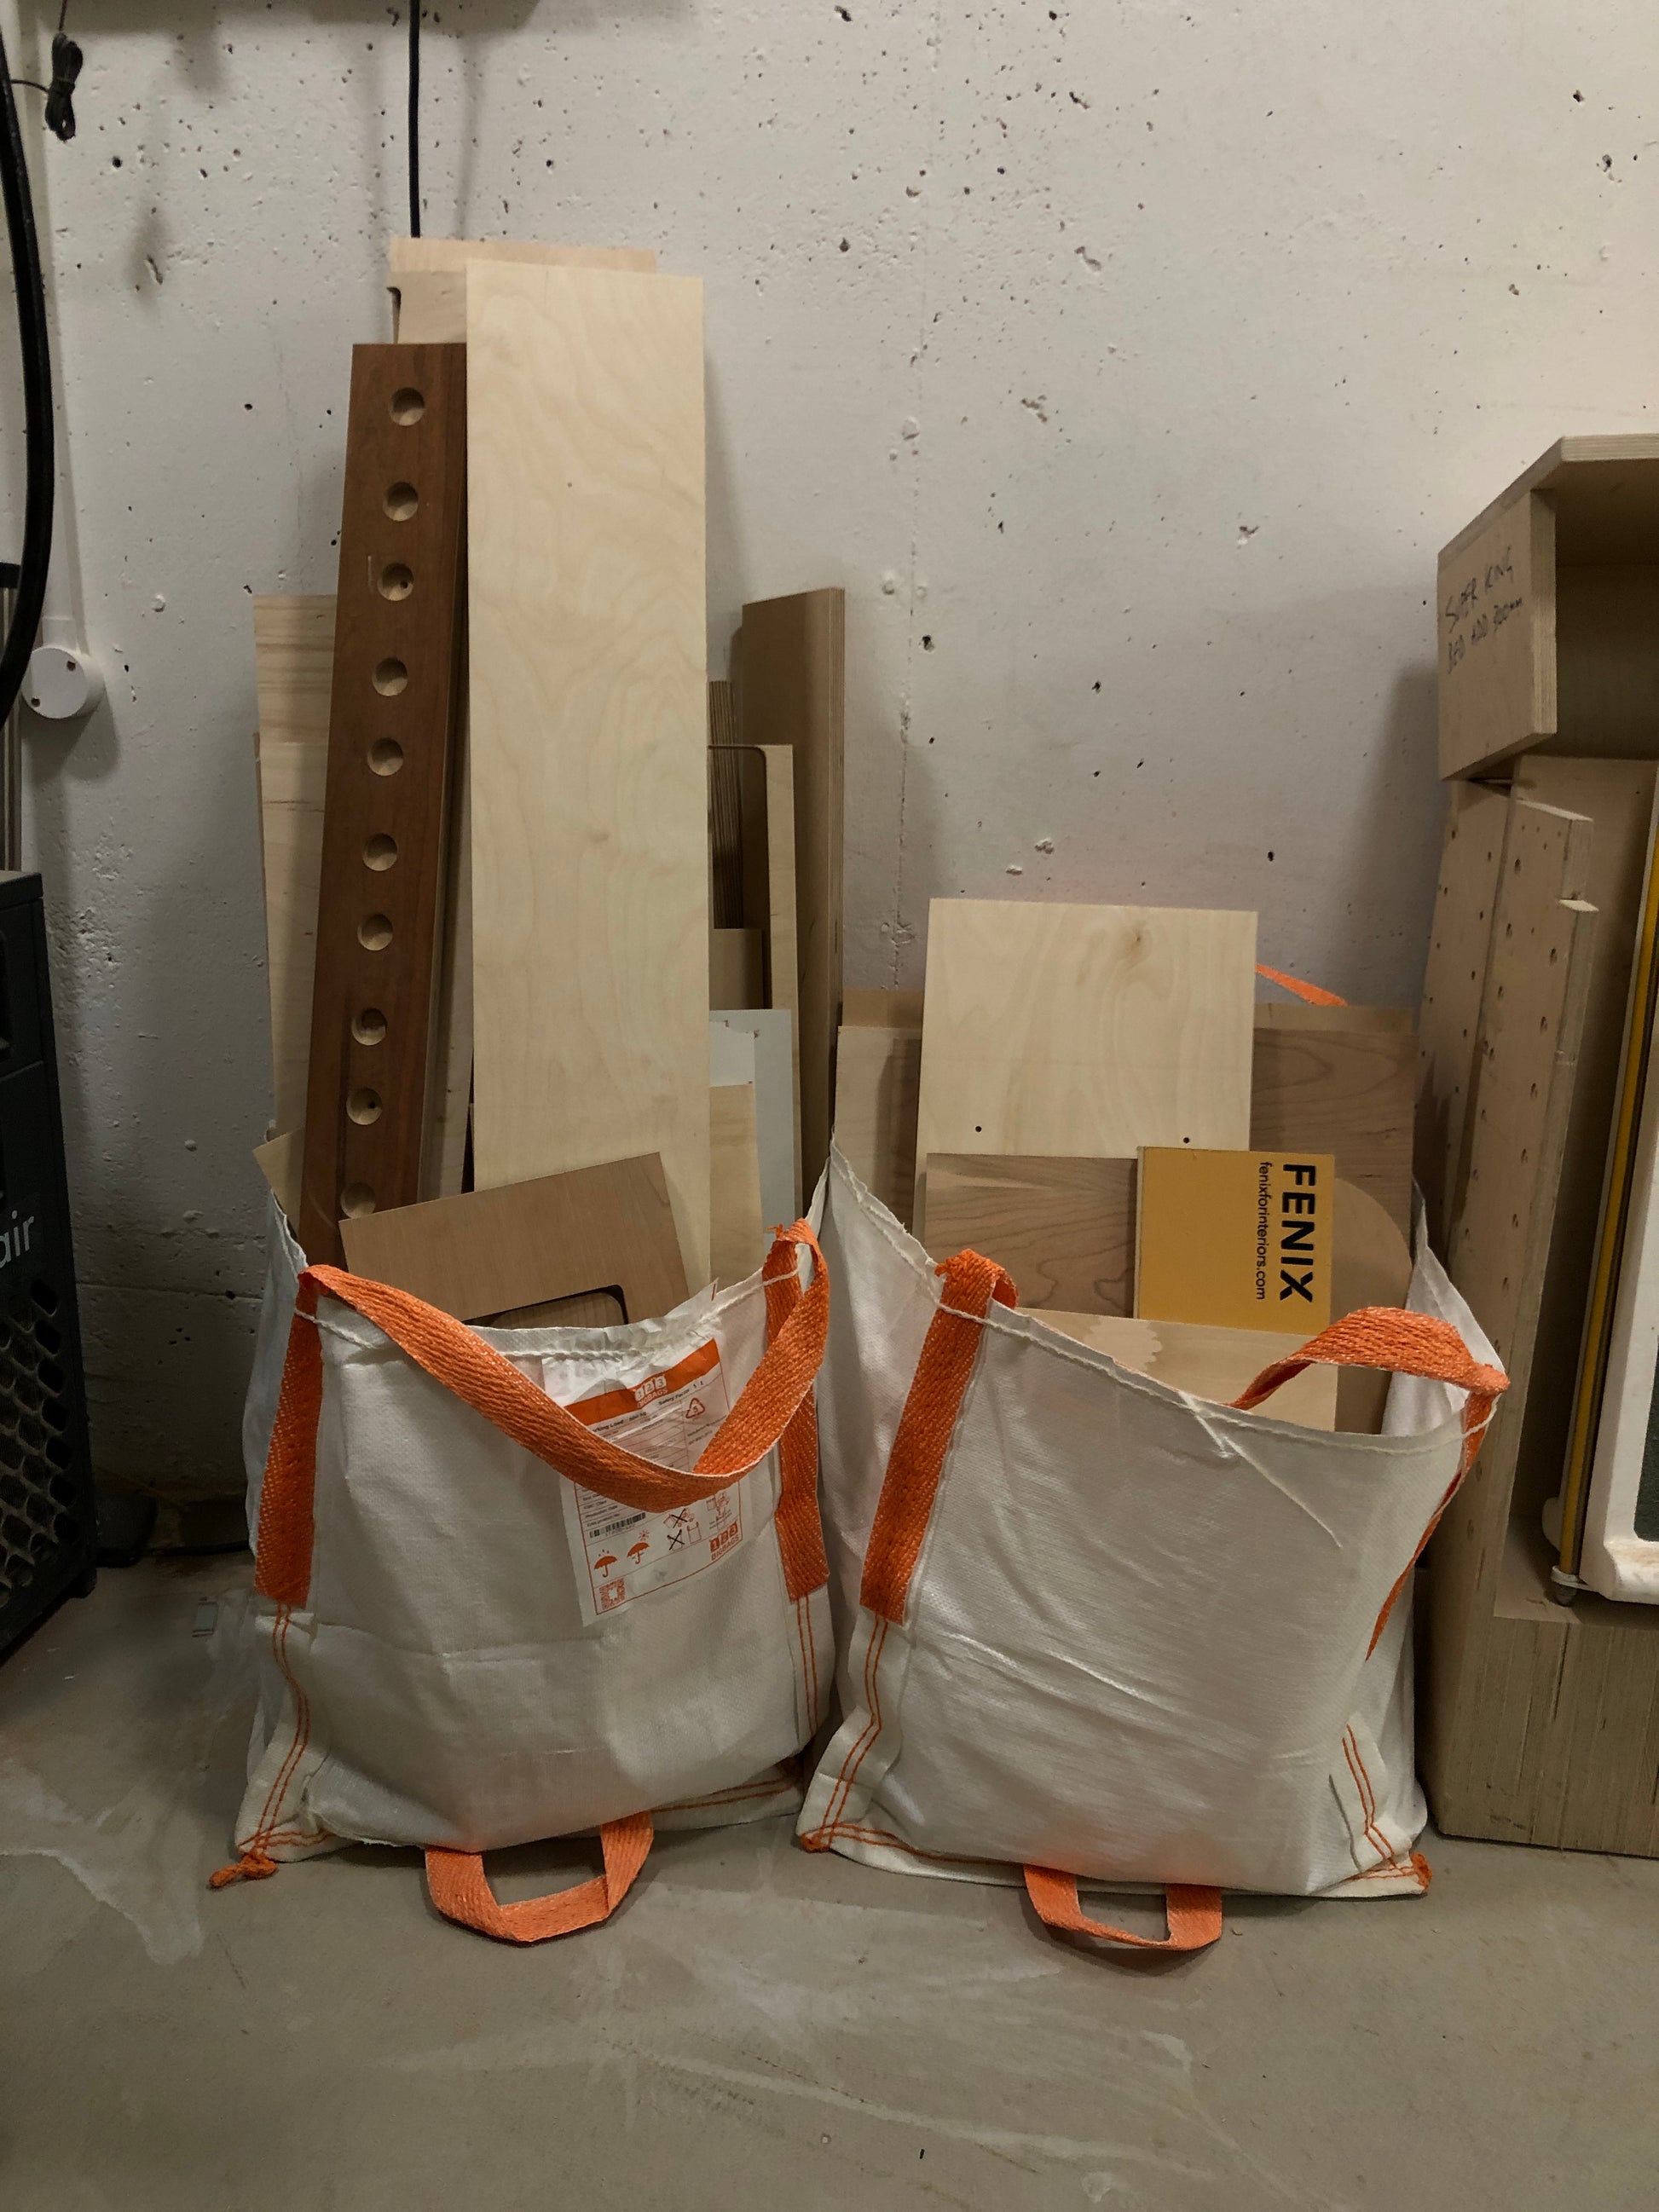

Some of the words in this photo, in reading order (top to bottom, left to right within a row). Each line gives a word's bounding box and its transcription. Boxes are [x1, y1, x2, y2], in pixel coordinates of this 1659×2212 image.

[1445, 578, 1478, 634] SUPER
[1484, 546, 1515, 596] KING
[1446, 634, 1466, 675] BED
[1471, 612, 1489, 646] ADD
[1256, 1162, 1273, 1300] fenixforinteriors.com
[1280, 1164, 1316, 1302] FENIX
[592, 1424, 610, 1433] orking
[637, 1388, 668, 1408] BIGBAGS
[711, 1535, 740, 1562] BIGBAGS
